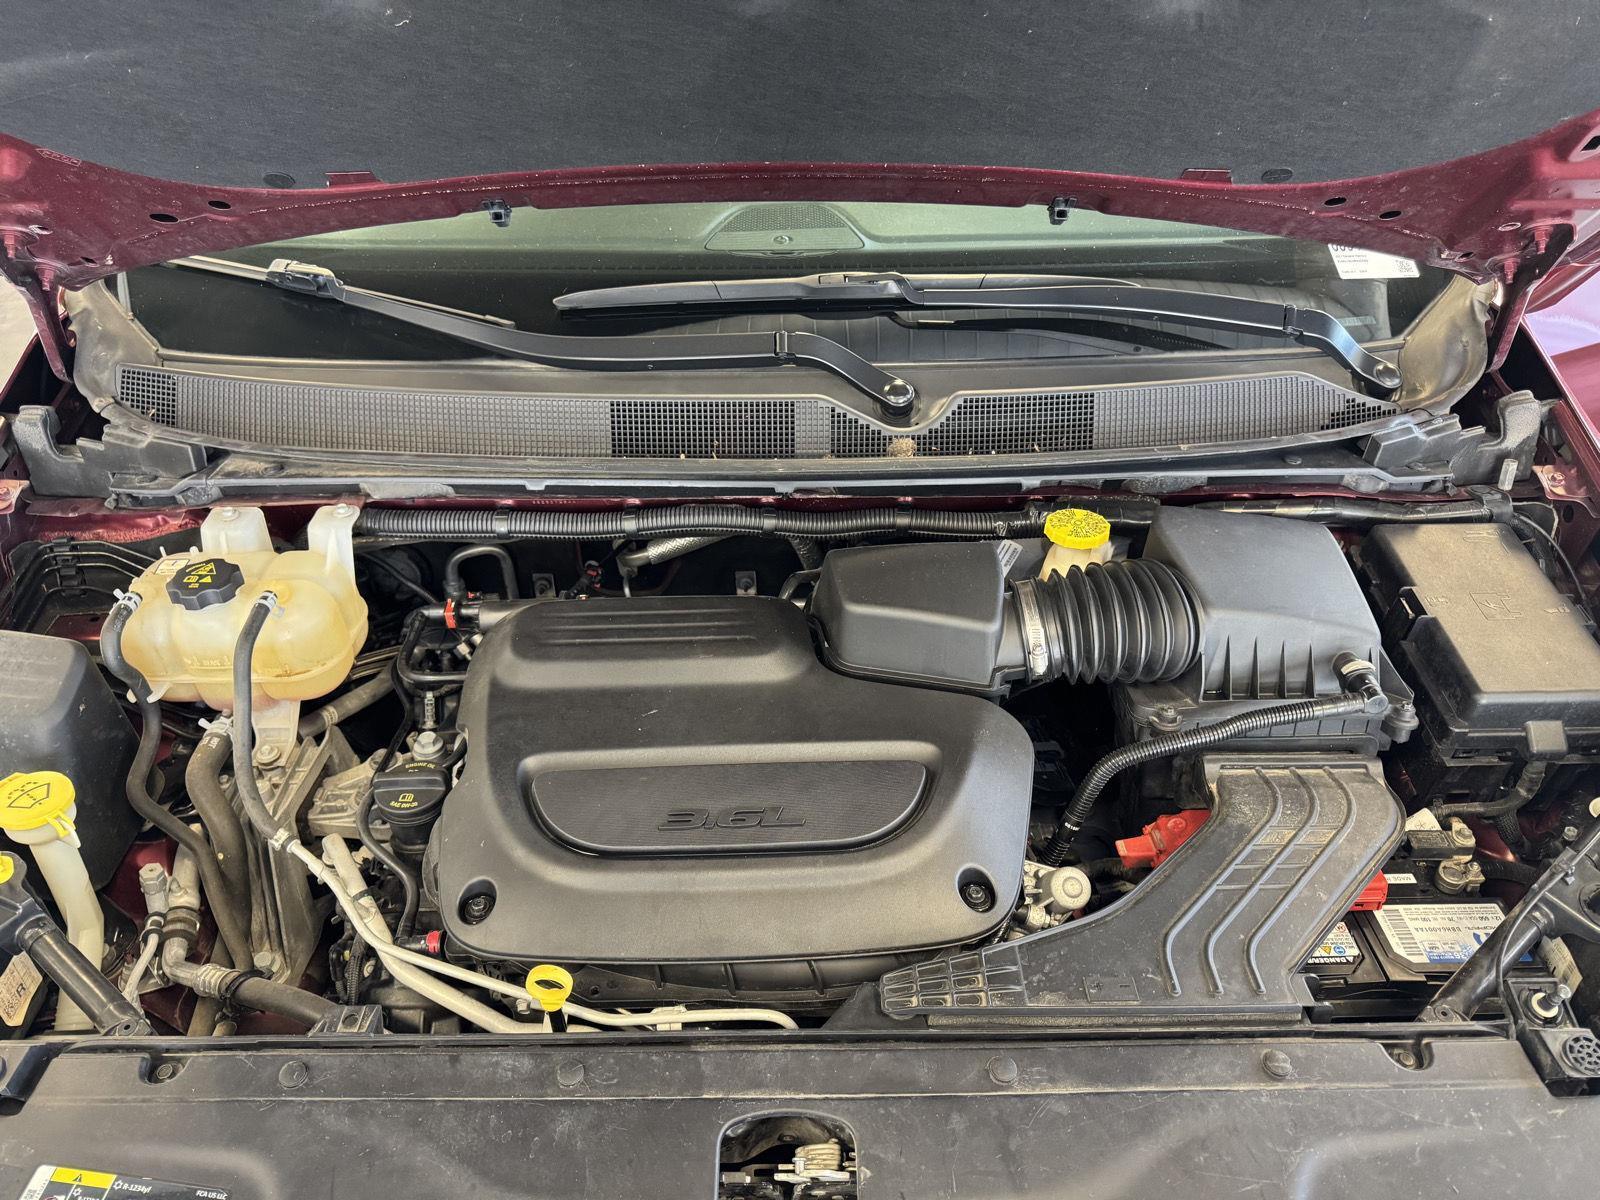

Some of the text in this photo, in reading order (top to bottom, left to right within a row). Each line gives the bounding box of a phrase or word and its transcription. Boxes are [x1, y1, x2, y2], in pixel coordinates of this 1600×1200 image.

[658, 806, 806, 831] 3.6L
[122, 1183, 152, 1194] R-1234yf
[195, 1189, 227, 1200] FCA US LLC
